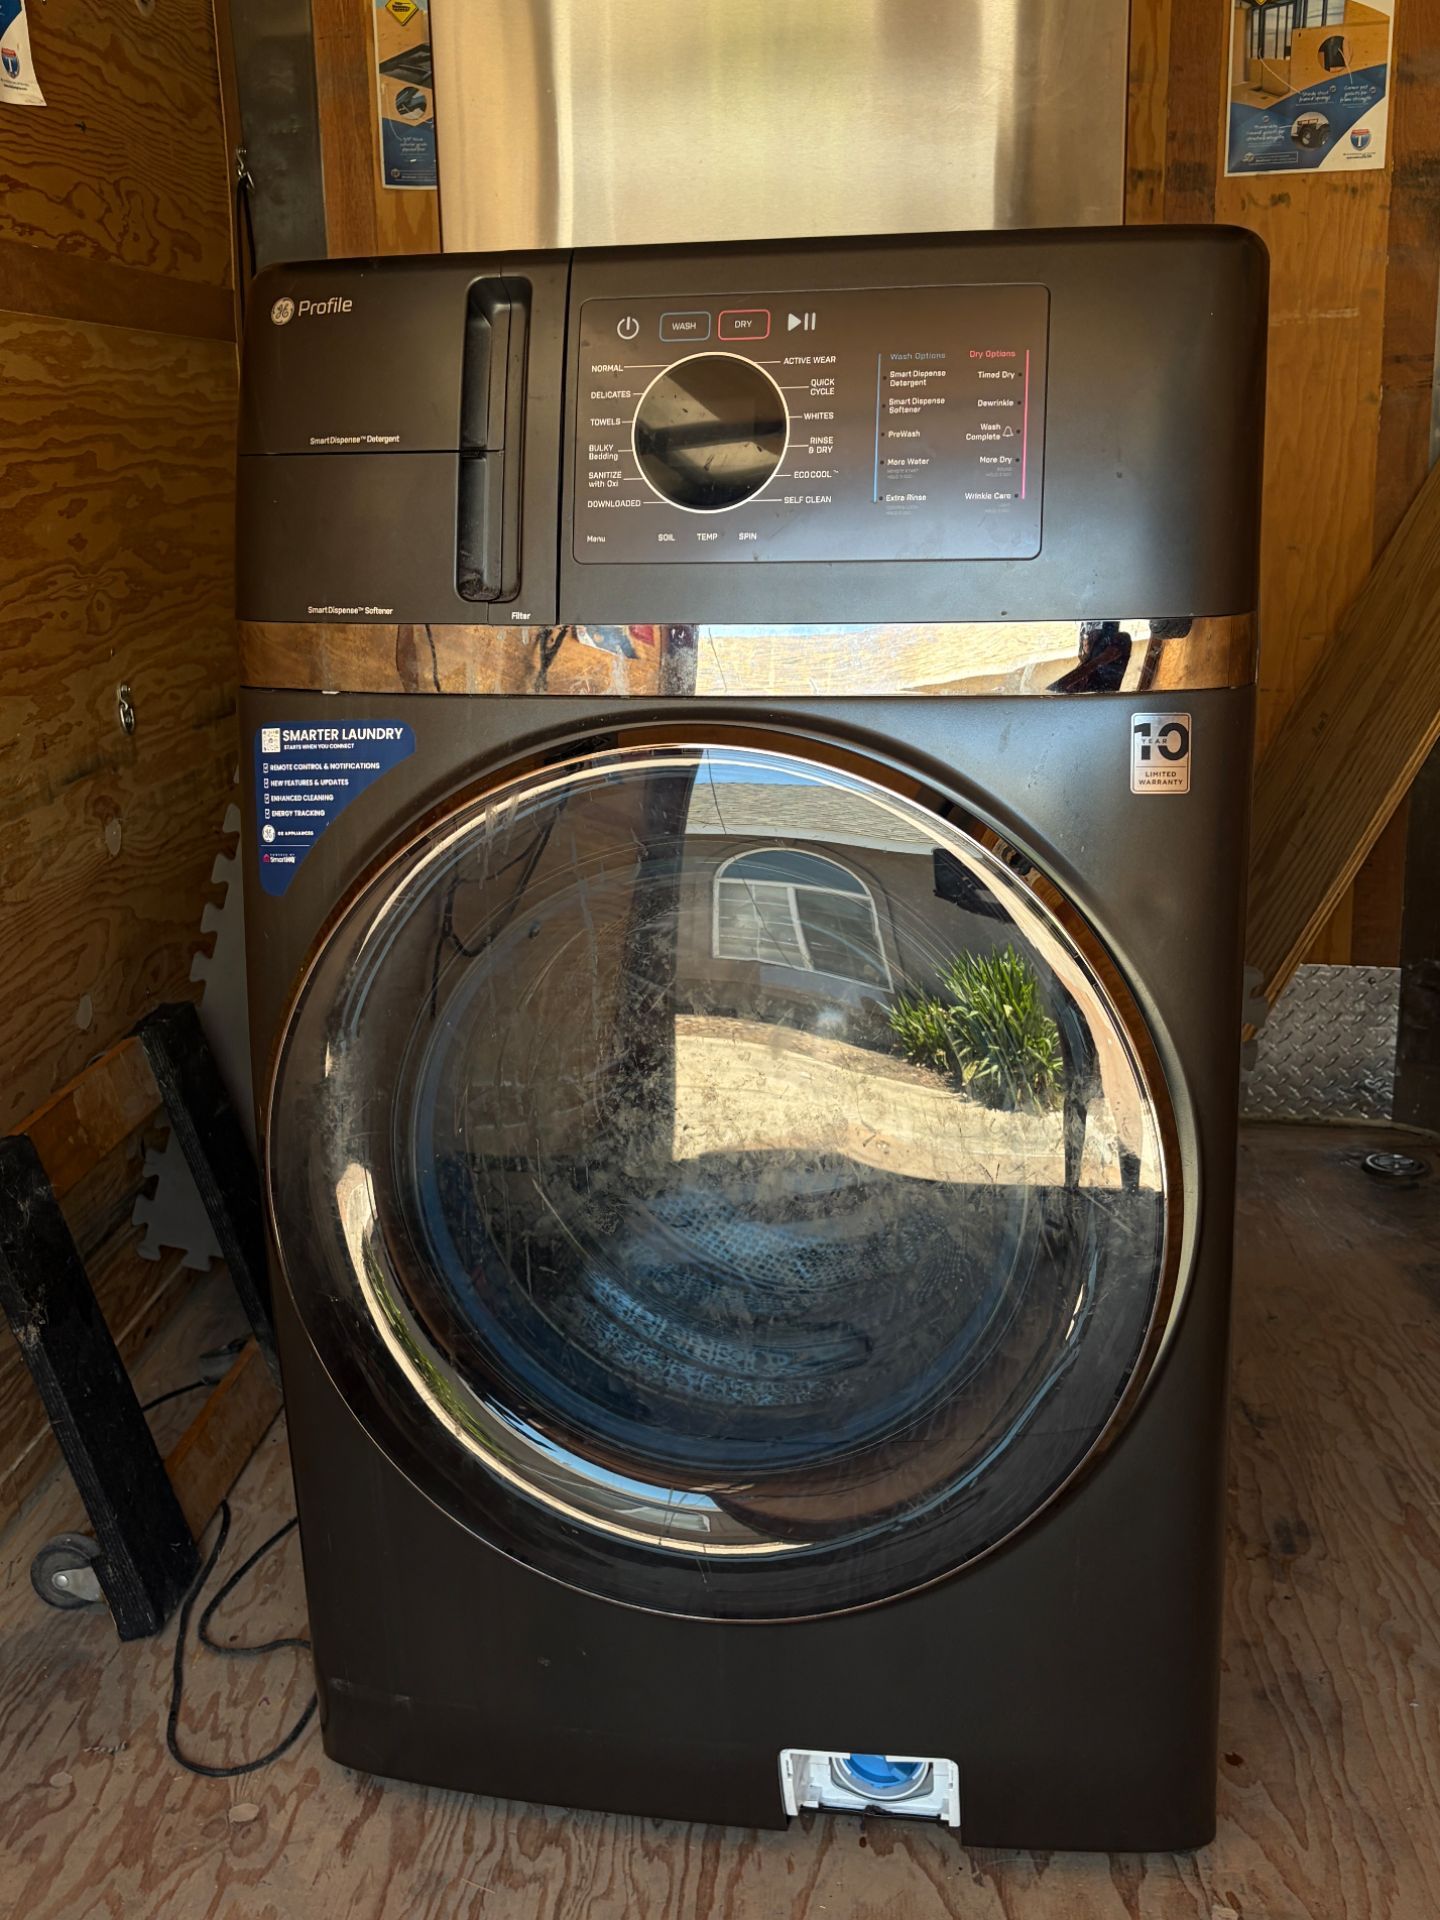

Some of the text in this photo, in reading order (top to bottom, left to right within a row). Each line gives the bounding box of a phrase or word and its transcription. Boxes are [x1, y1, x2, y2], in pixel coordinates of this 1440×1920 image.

[298, 296, 353, 317] Profile
[672, 321, 697, 331] WASH
[734, 320, 752, 329] DRY
[914, 352, 946, 361] Options
[969, 350, 1016, 359] Dry Options
[783, 355, 836, 365] ACTIVE WEAR
[591, 364, 624, 373] NORMAL
[889, 370, 946, 378] Smart Dispense
[978, 370, 1016, 380] Timed Dry
[810, 378, 835, 387] QUICK
[889, 379, 927, 388] Detergent
[590, 390, 632, 399] DELICATES
[810, 387, 835, 396] CYCLE
[889, 397, 946, 406] Smart Dispense
[977, 399, 1014, 407] Dewrinkle
[889, 406, 921, 414] Softener
[803, 411, 834, 420] WHITES
[590, 418, 621, 426] TOWELS
[980, 423, 1001, 431] Wash
[888, 429, 921, 439] PreWash
[965, 433, 1001, 442] Complete
[366, 435, 400, 445] Detergent
[810, 436, 834, 445] RINSE
[588, 444, 614, 453] BULKY
[808, 446, 833, 454] & DRY
[589, 452, 619, 462] Bedding
[887, 457, 930, 466] More Water
[980, 456, 1013, 465] More Dry
[588, 471, 622, 479] SANITIZE
[588, 479, 619, 488] with Oxi
[784, 495, 832, 504] SELF CLEAN
[886, 493, 927, 502] Extra Rinse
[964, 491, 1012, 500] Wrinkle Care
[587, 499, 642, 508] DOWNLOADED
[587, 535, 606, 544] Menu
[657, 533, 676, 542] SOIL
[697, 532, 718, 541] TEMP
[738, 532, 757, 541] SPIN
[364, 606, 394, 615] Softener
[511, 611, 531, 621] Filter
[282, 727, 404, 742] SMARTER LAUNDRY
[1134, 722, 1189, 761] 10
[269, 763, 293, 771] REMOTE
[293, 763, 322, 771] CONTROL
[330, 762, 380, 770] NOTIFICATIONS
[270, 779, 284, 787] NEW
[284, 779, 314, 787] FEATURES
[320, 778, 349, 786] UPDATES
[303, 794, 334, 802] CLEANING
[271, 809, 326, 818] ENERGY TRACKING
